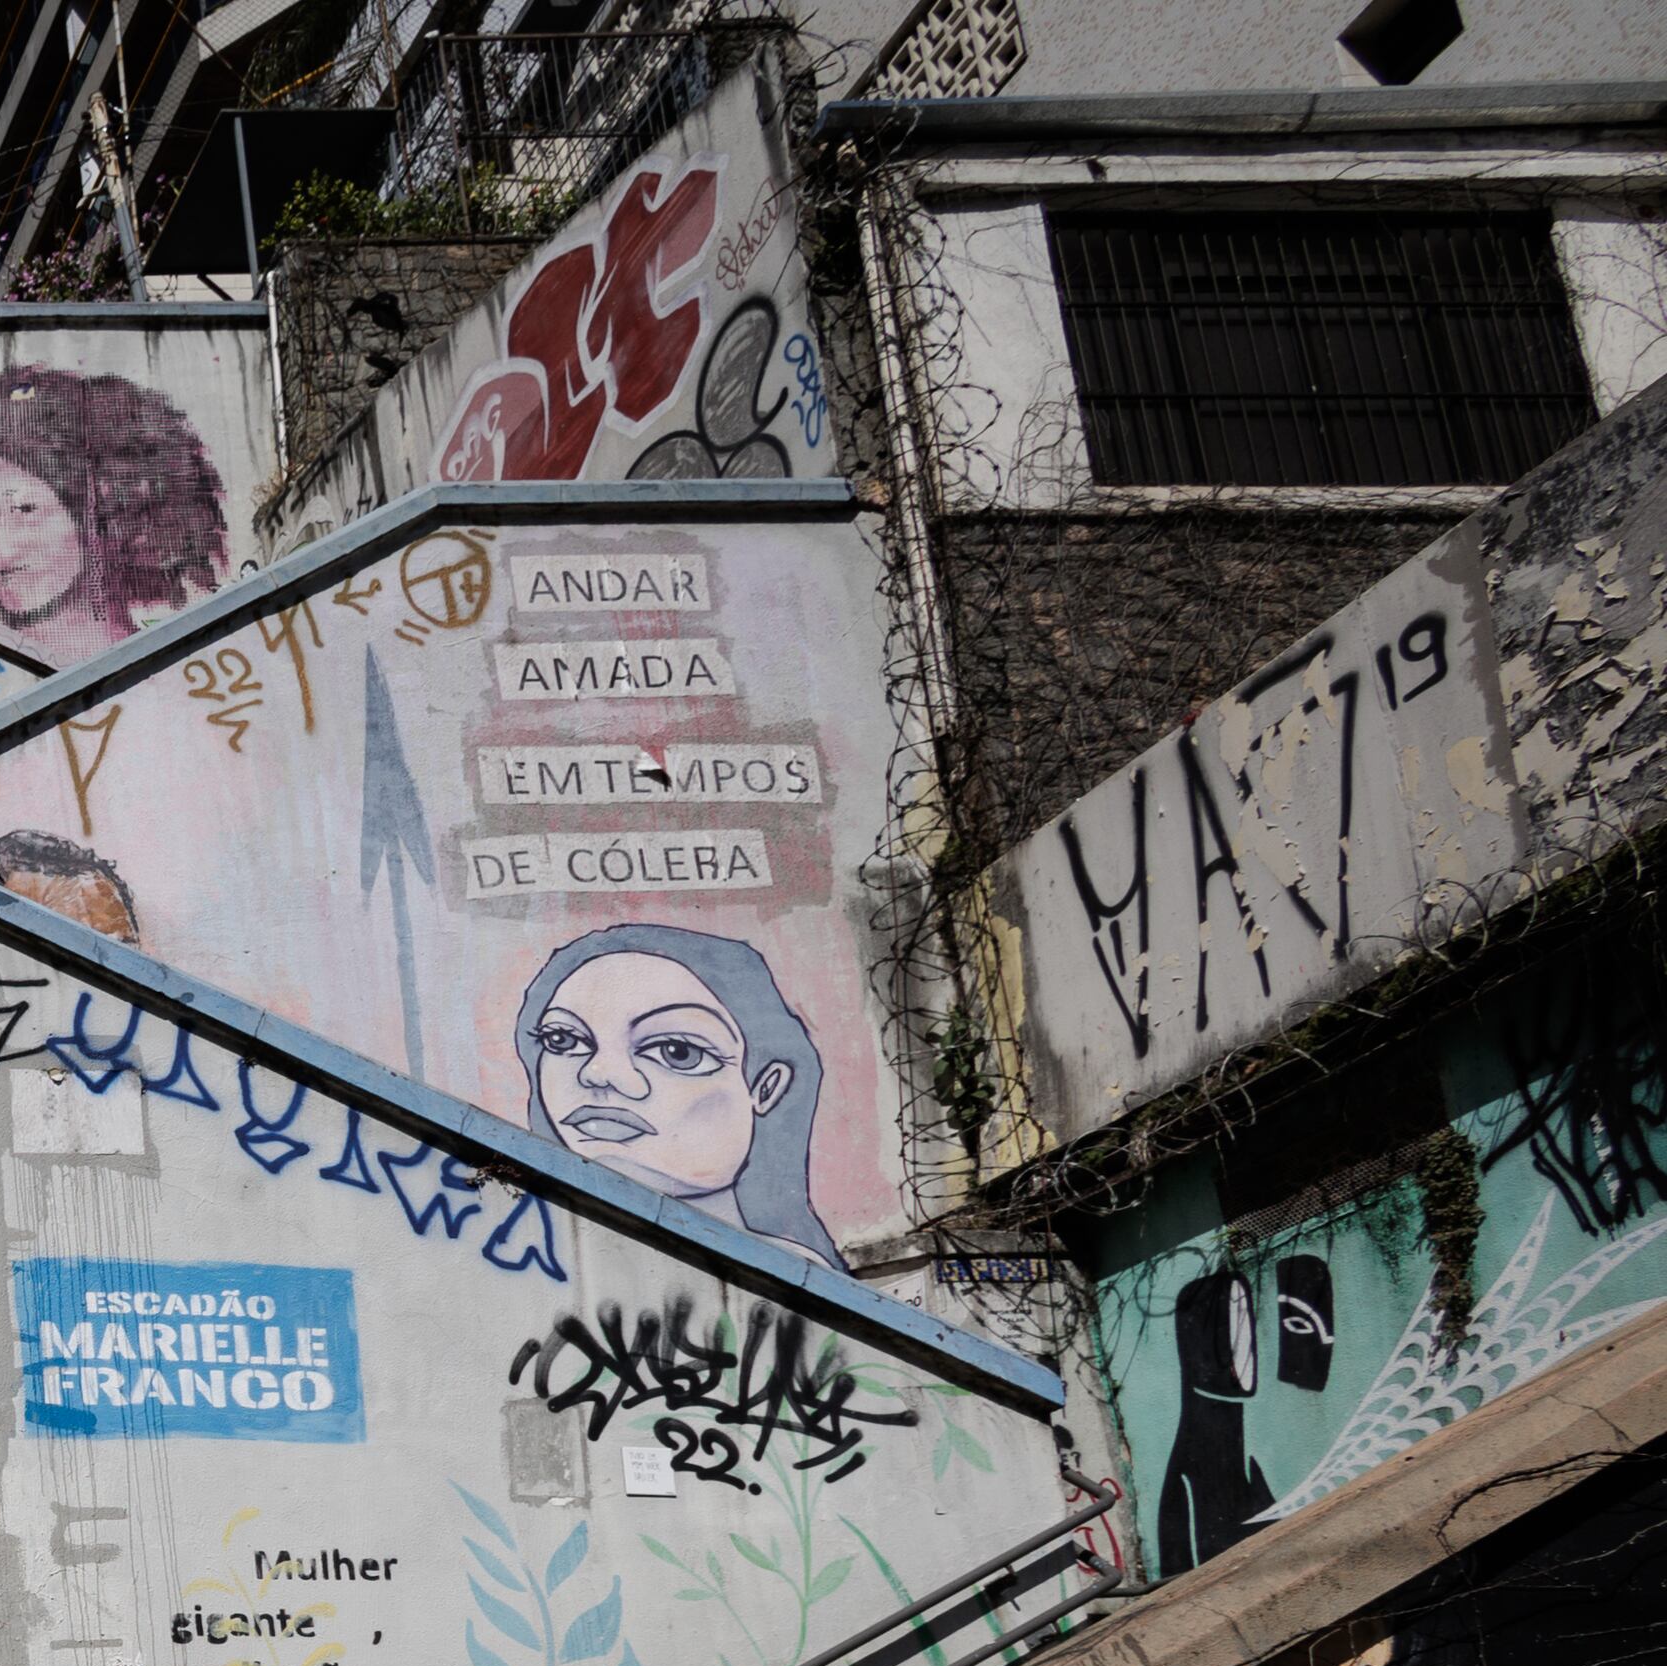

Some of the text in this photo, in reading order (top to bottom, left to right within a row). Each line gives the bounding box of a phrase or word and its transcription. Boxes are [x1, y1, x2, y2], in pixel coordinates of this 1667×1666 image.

[528, 567, 700, 604] ANDAR
[517, 653, 718, 691] AMADA
[507, 757, 810, 795] EM TEMPOS
[473, 838, 759, 889] DE CÓLERA
[84, 1287, 277, 1321] ESCADÃO
[39, 1319, 329, 1368] MARIELLE
[43, 1365, 336, 1412] FRANCO
[254, 1549, 399, 1582] Mulher
[170, 1604, 317, 1646] gigante
